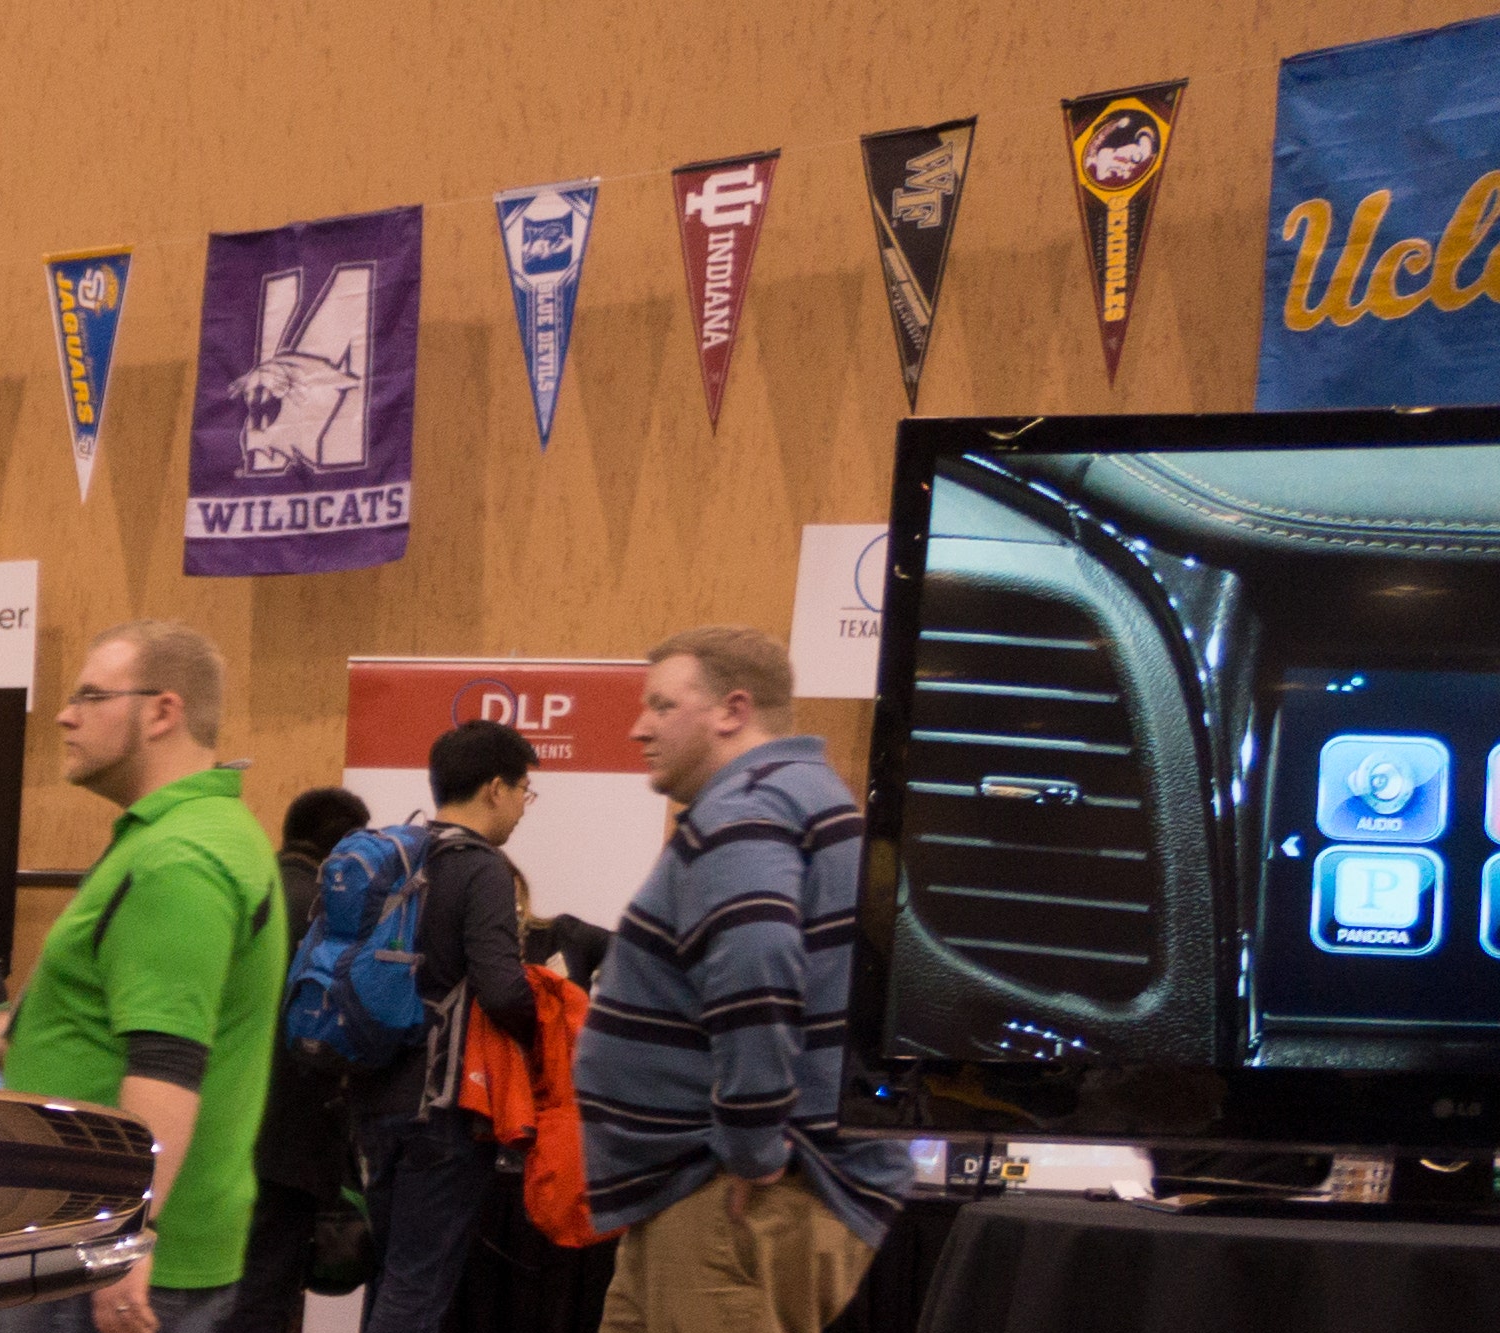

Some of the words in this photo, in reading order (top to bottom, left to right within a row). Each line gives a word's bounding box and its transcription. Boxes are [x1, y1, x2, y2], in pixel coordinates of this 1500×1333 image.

[1103, 197, 1128, 322] SEMINOLES
[536, 282, 555, 326] BLUE
[701, 229, 735, 350] INDIANA
[56, 272, 94, 425] JAGUARS
[536, 330, 554, 393] DEVILS
[196, 487, 403, 537] WILDCATS
[839, 620, 880, 638] TEXA
[481, 693, 572, 730] DLP
[1356, 816, 1403, 832] AUDIO
[1336, 927, 1411, 946] PANDORA
